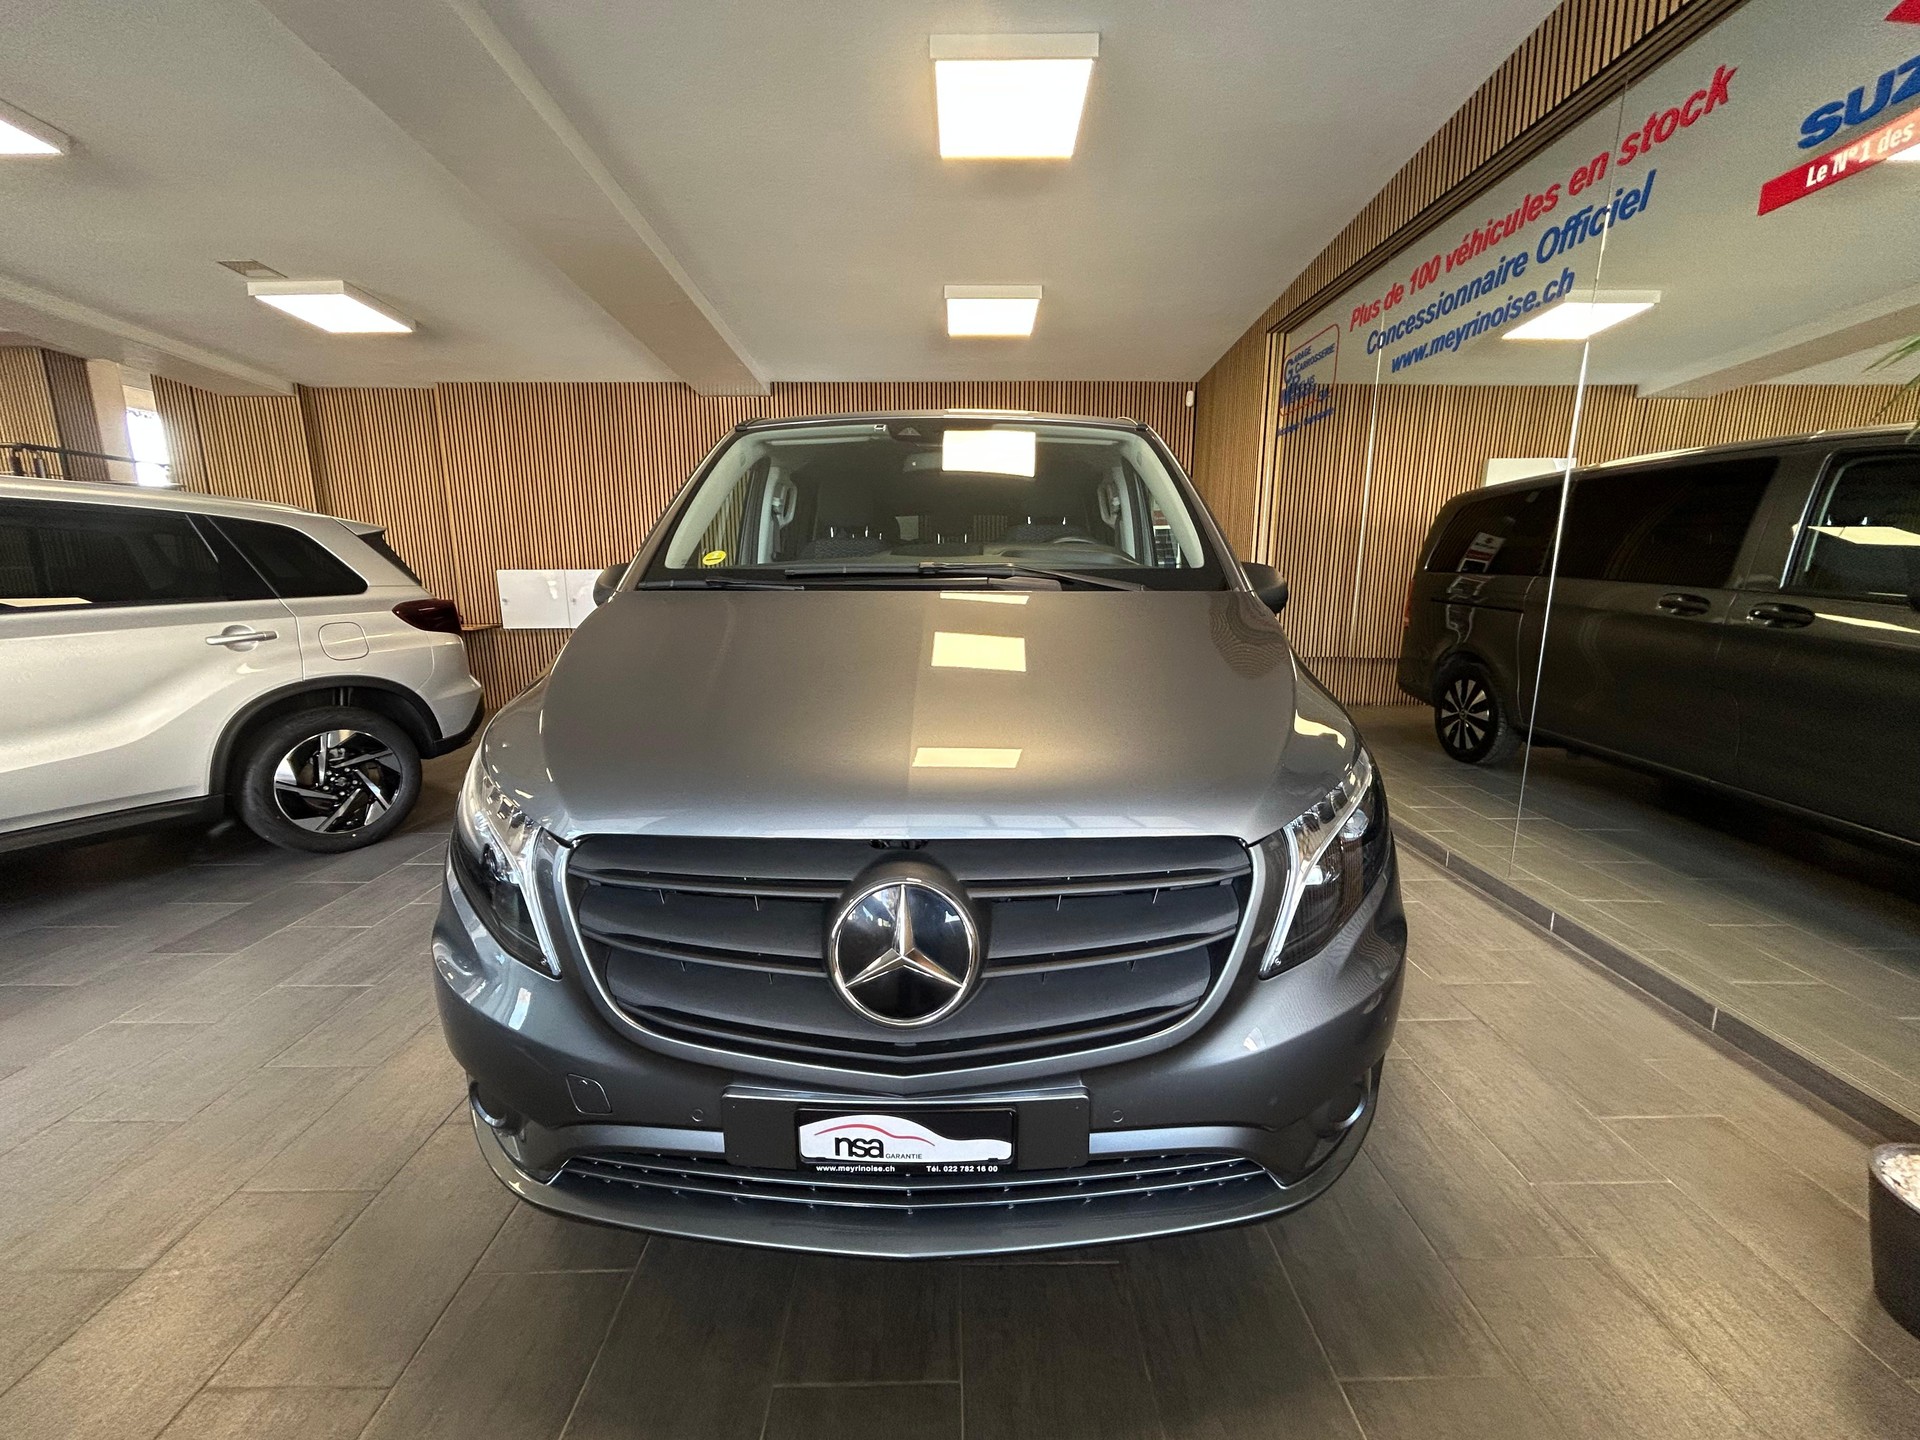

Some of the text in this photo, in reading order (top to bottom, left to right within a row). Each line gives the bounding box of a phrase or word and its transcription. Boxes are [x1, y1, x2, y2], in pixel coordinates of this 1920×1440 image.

[1805, 164, 1827, 188] Le
[1877, 122, 1916, 154] des
[1349, 64, 1738, 333] Plus de 100 véhicules en stock
[1366, 168, 1657, 355] Concessionnaire Officiel
[1391, 267, 1575, 373] www.meyrinoise.ch
[815, 1165, 896, 1173] www.meyrinoise.ch
[834, 1137, 884, 1159] nsa
[926, 1165, 999, 1173] Tél. 022 782 16 00
